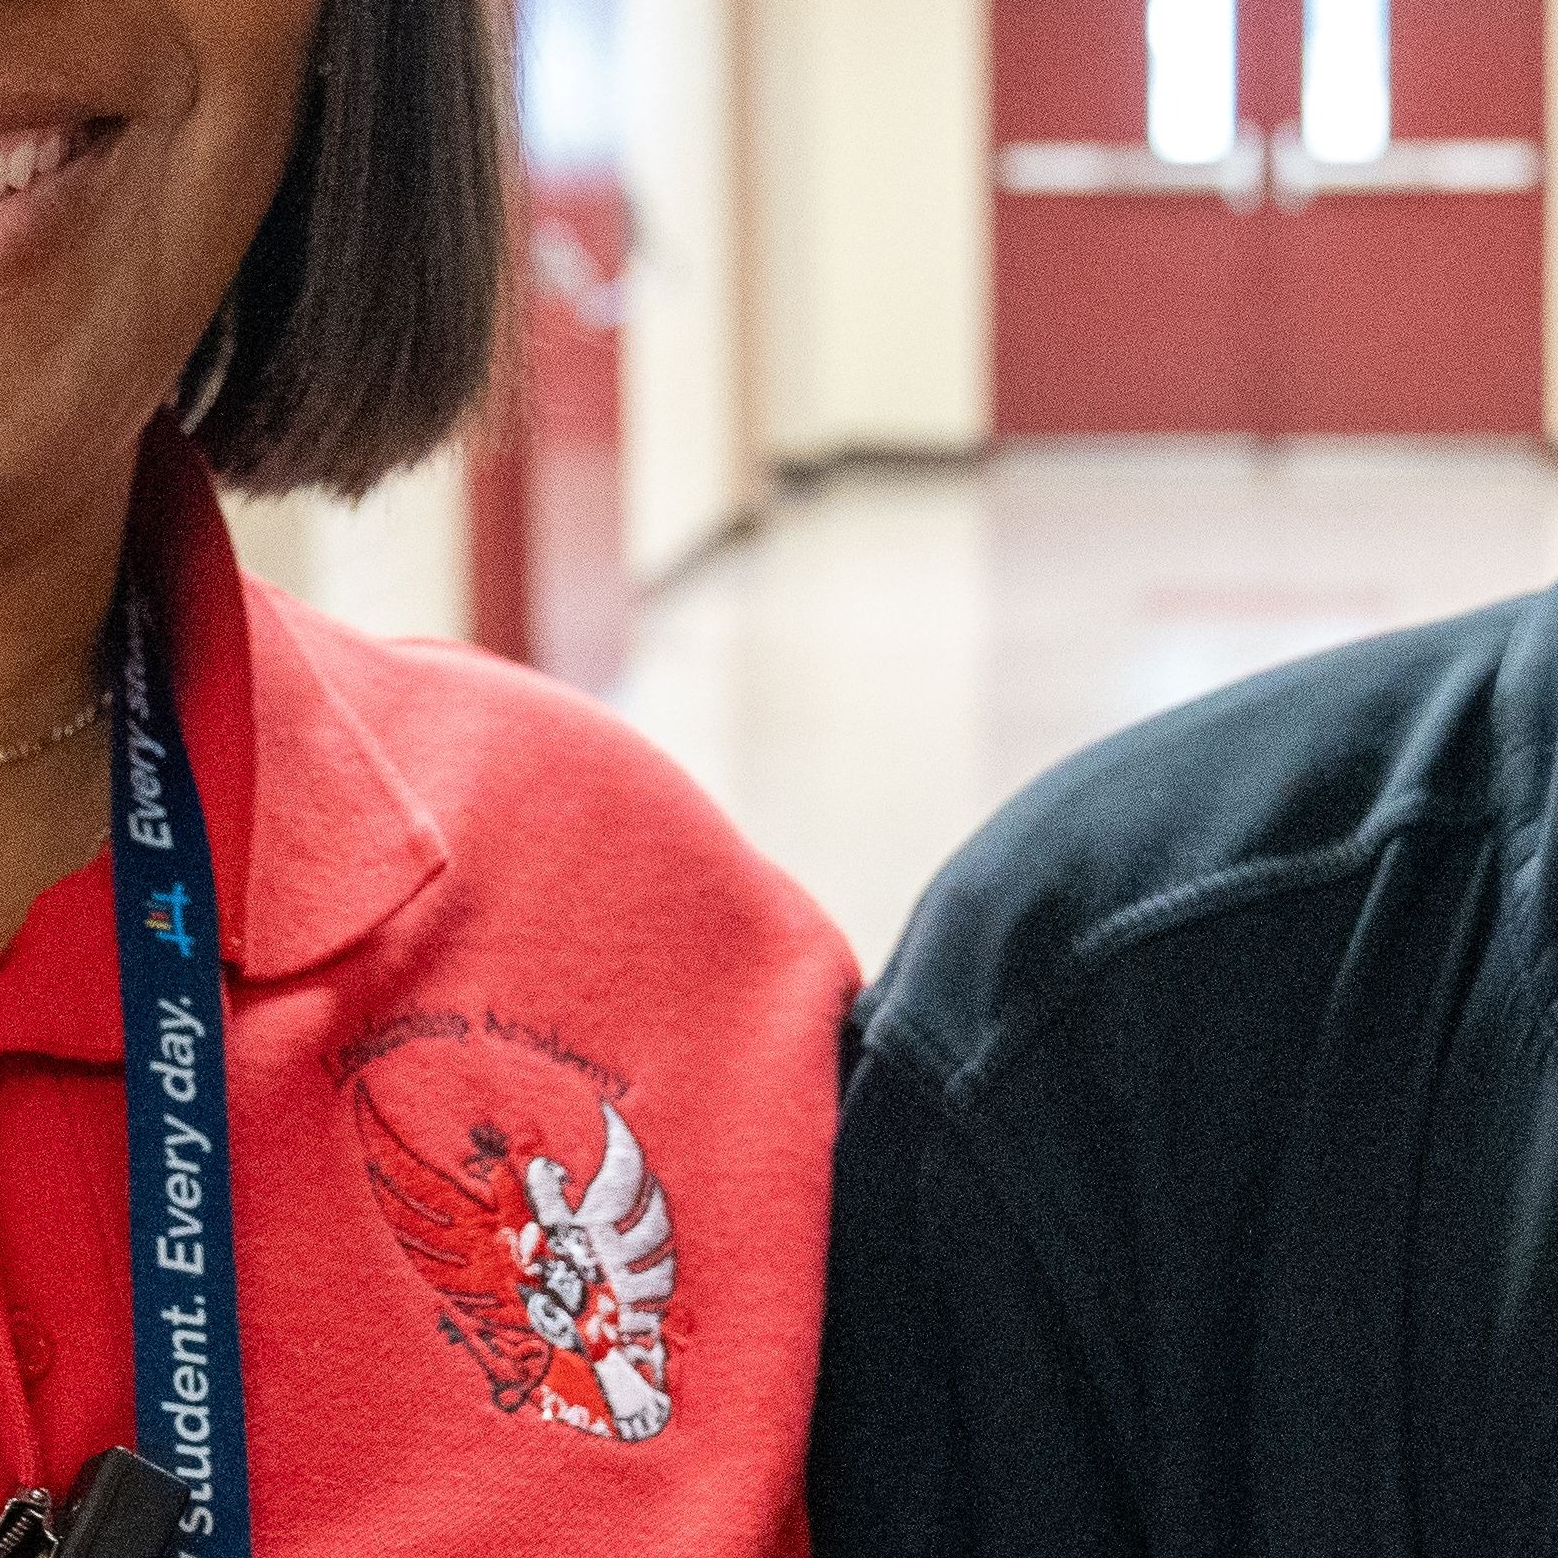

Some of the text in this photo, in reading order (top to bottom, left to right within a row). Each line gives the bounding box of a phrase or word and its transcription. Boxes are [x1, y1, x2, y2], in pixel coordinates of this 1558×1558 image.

[127, 720, 174, 850] Every
[149, 995, 205, 1104] day.
[157, 1115, 212, 1276] Every
